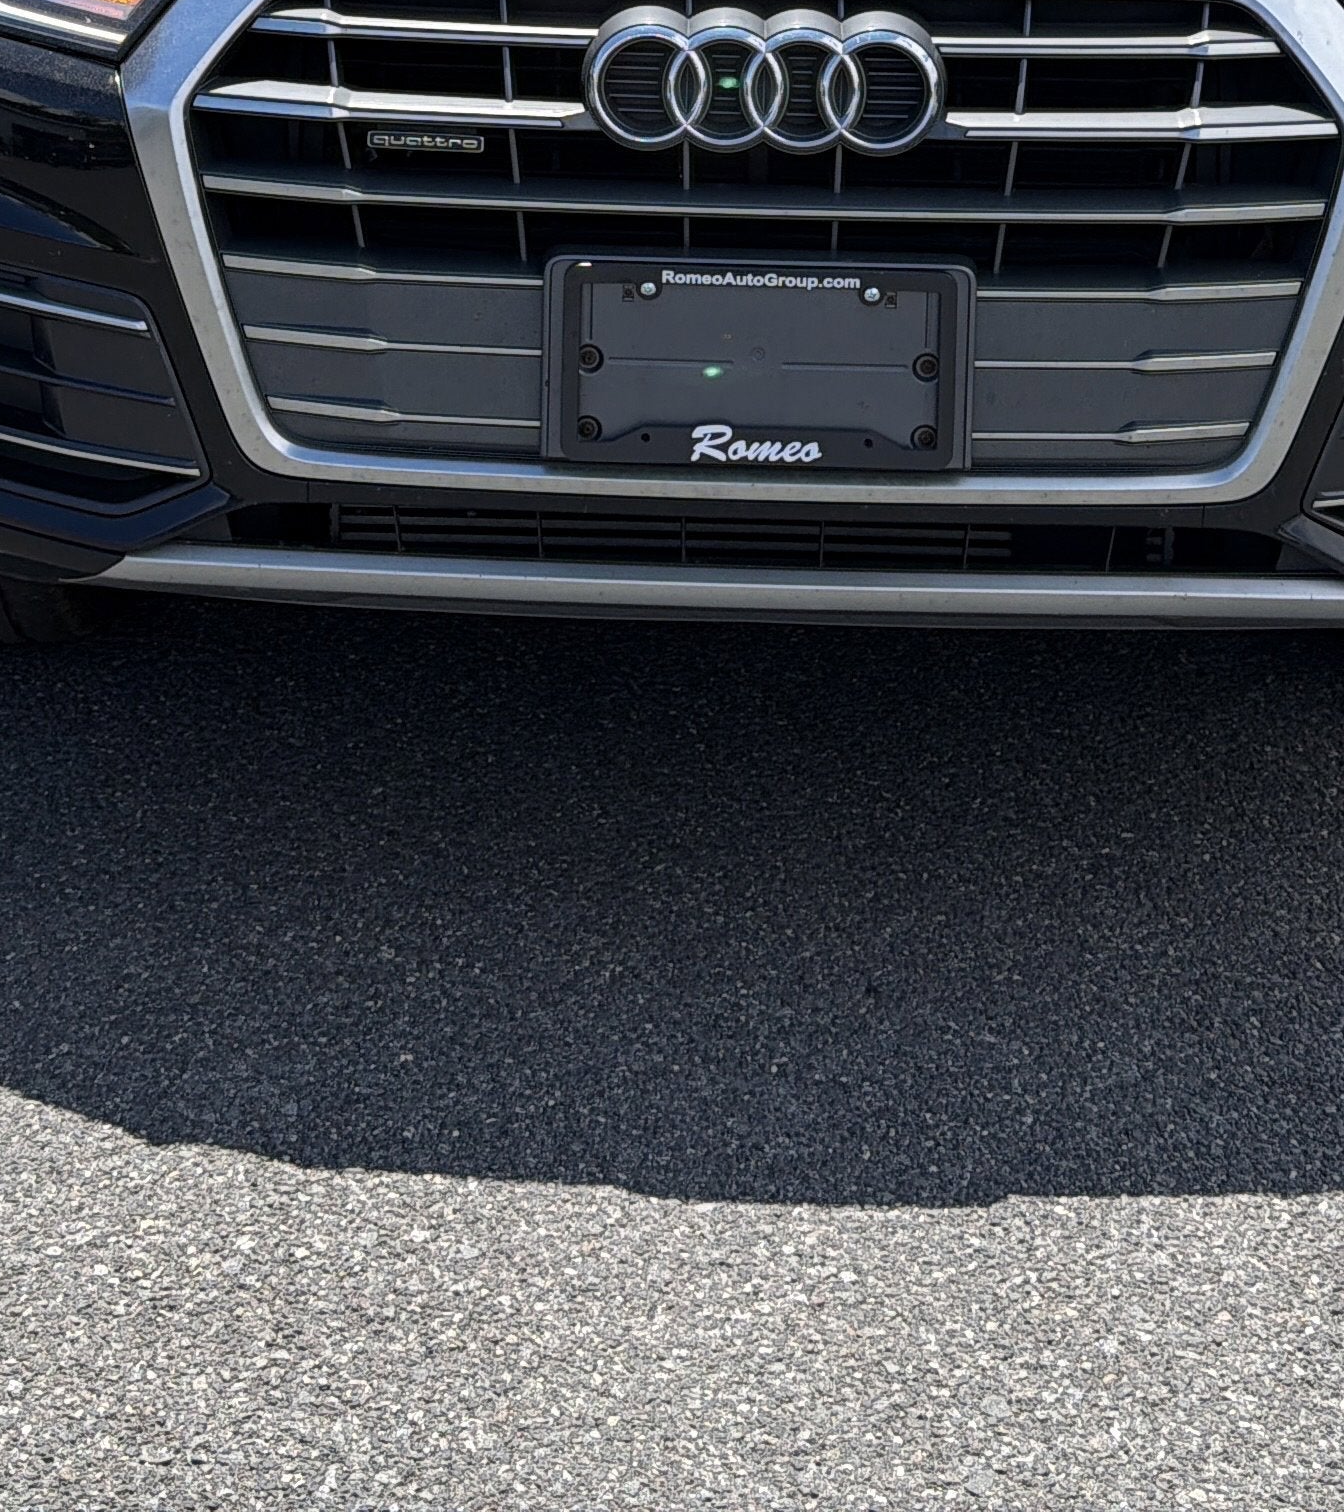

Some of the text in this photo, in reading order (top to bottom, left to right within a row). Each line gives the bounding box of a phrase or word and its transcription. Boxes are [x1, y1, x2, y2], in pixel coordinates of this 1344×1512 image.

[373, 135, 478, 148] quattro
[661, 269, 861, 290] RomeoAutoGroup.com
[690, 424, 823, 462] Romeo
